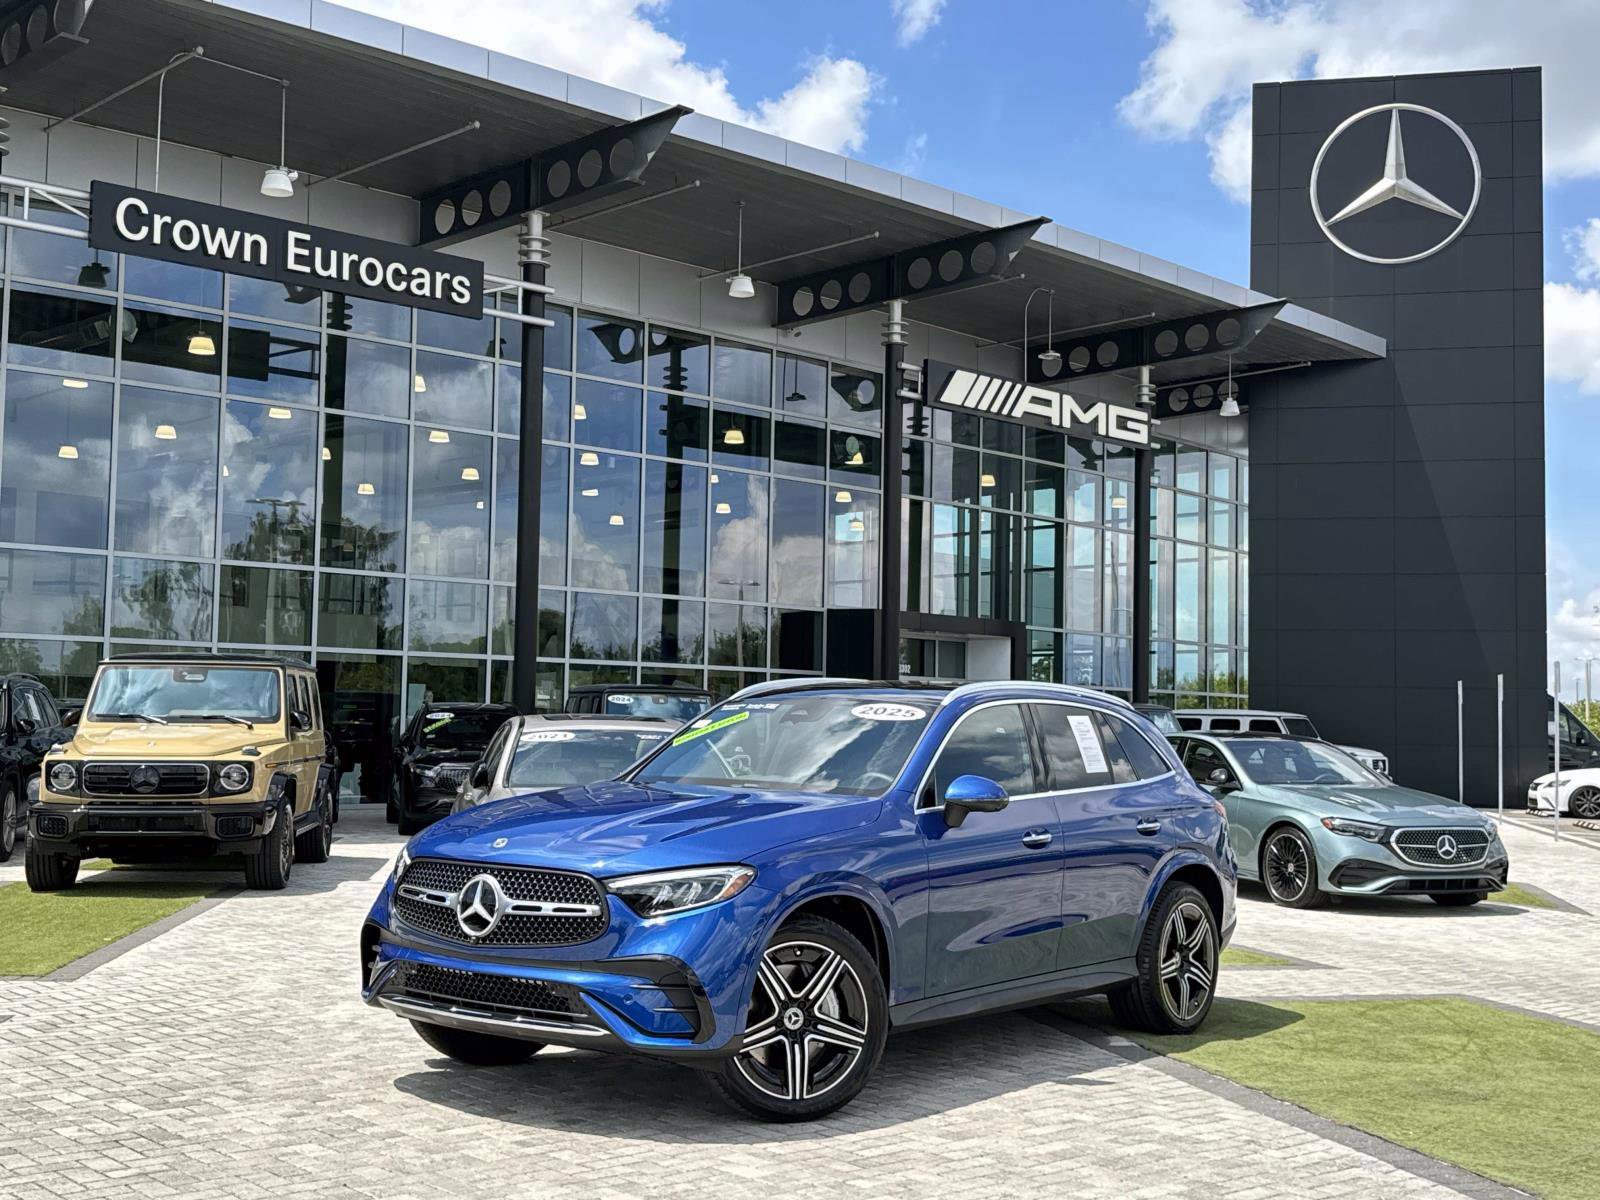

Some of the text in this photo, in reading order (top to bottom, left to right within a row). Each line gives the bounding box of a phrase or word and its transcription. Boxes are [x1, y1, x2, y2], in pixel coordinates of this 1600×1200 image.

[115, 197, 471, 304] Crown Eurocars
[1011, 385, 1148, 444] AMG
[858, 706, 918, 717] 2025
